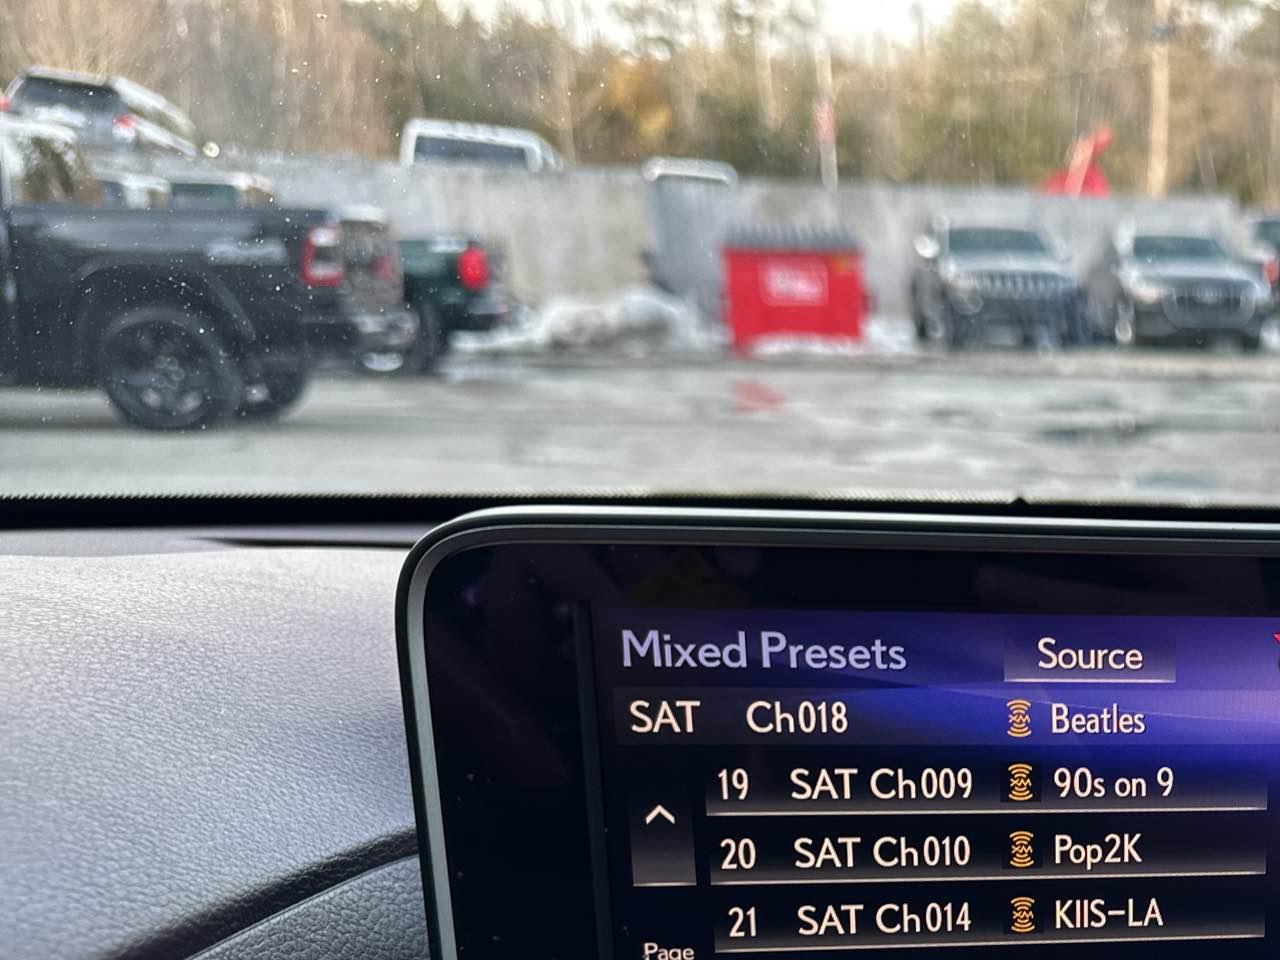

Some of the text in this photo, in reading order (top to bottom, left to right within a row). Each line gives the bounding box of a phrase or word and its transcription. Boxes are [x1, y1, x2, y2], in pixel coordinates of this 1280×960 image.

[622, 629, 906, 669] Mixed Presets
[1039, 638, 1142, 669] Source
[631, 701, 700, 732] SAT
[1052, 703, 1145, 733] Beatles
[719, 769, 748, 799] 19
[791, 769, 857, 799] SAT
[1055, 767, 1173, 797] 90s on 9
[721, 839, 755, 869] 20
[795, 838, 860, 867] SAT
[1055, 834, 1142, 868] Pop2K
[729, 907, 755, 936] 21
[798, 905, 863, 934] SAT
